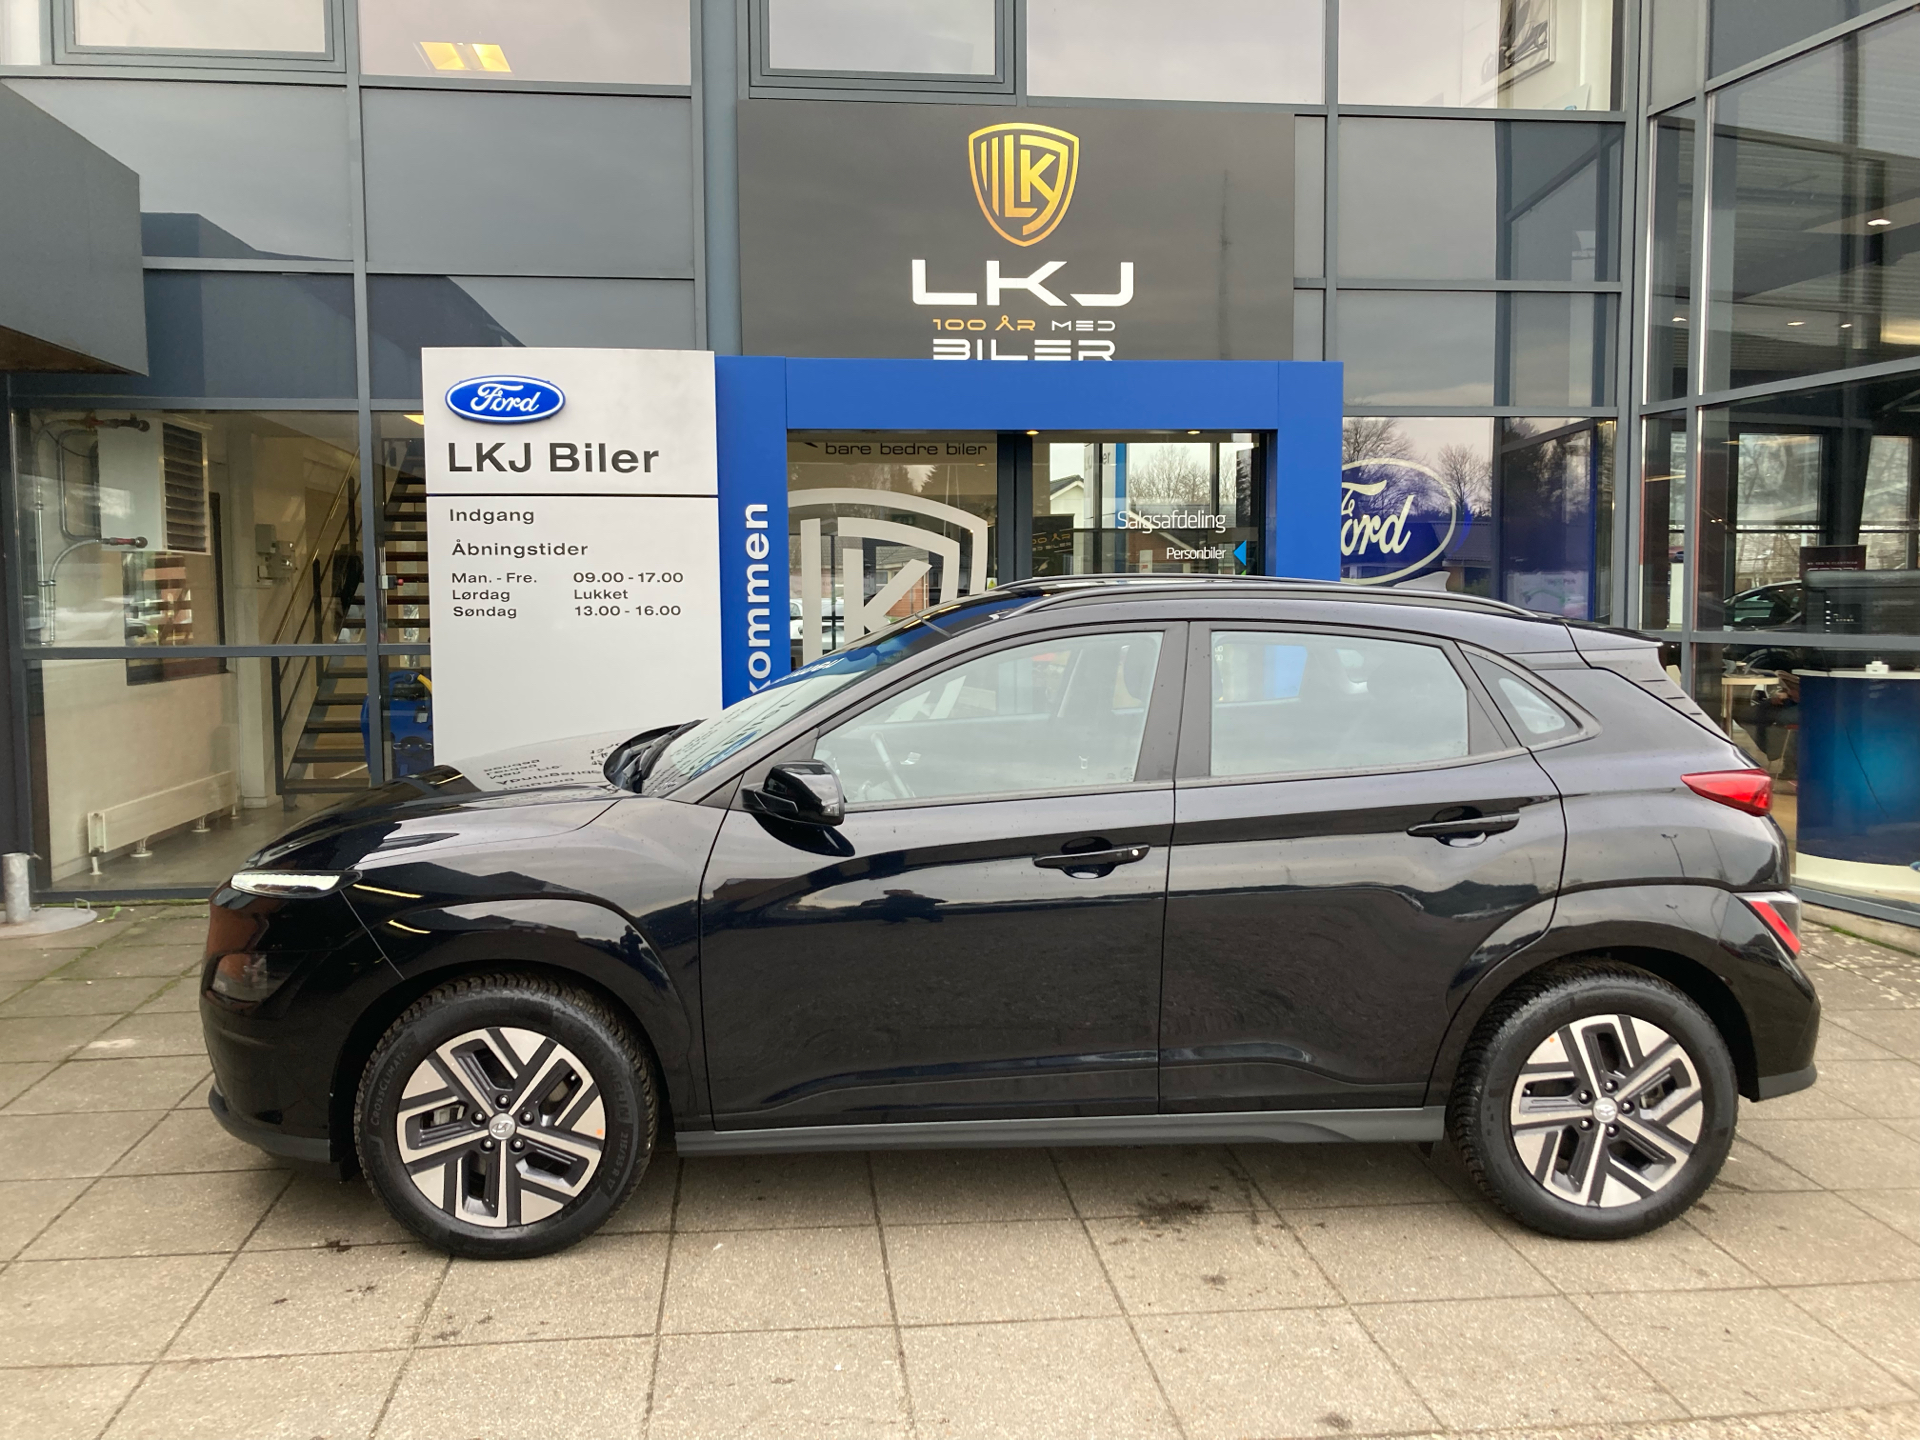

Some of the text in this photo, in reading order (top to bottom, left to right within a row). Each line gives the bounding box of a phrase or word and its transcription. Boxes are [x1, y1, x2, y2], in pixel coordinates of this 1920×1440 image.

[911, 259, 1135, 307] LKJ
[932, 314, 1116, 331] 100 ÅR MED
[932, 338, 1116, 361] BILER
[469, 383, 541, 412] Ford
[448, 442, 660, 474] LKJ Biler
[825, 443, 988, 456] bare bedre biler
[449, 508, 535, 525] Indgang
[1117, 509, 1227, 534] Salgsafdeling
[451, 538, 589, 559] Åbningstider
[1166, 546, 1227, 560] Personbiler
[451, 572, 492, 583] Man.
[506, 572, 538, 583] Fre.
[573, 572, 624, 583] 09.00
[637, 572, 684, 583] 17.00
[452, 589, 629, 602] Lørdag Lukket
[453, 606, 517, 619] Søndag
[574, 605, 621, 616] 13.00
[635, 605, 682, 616] 16.00
